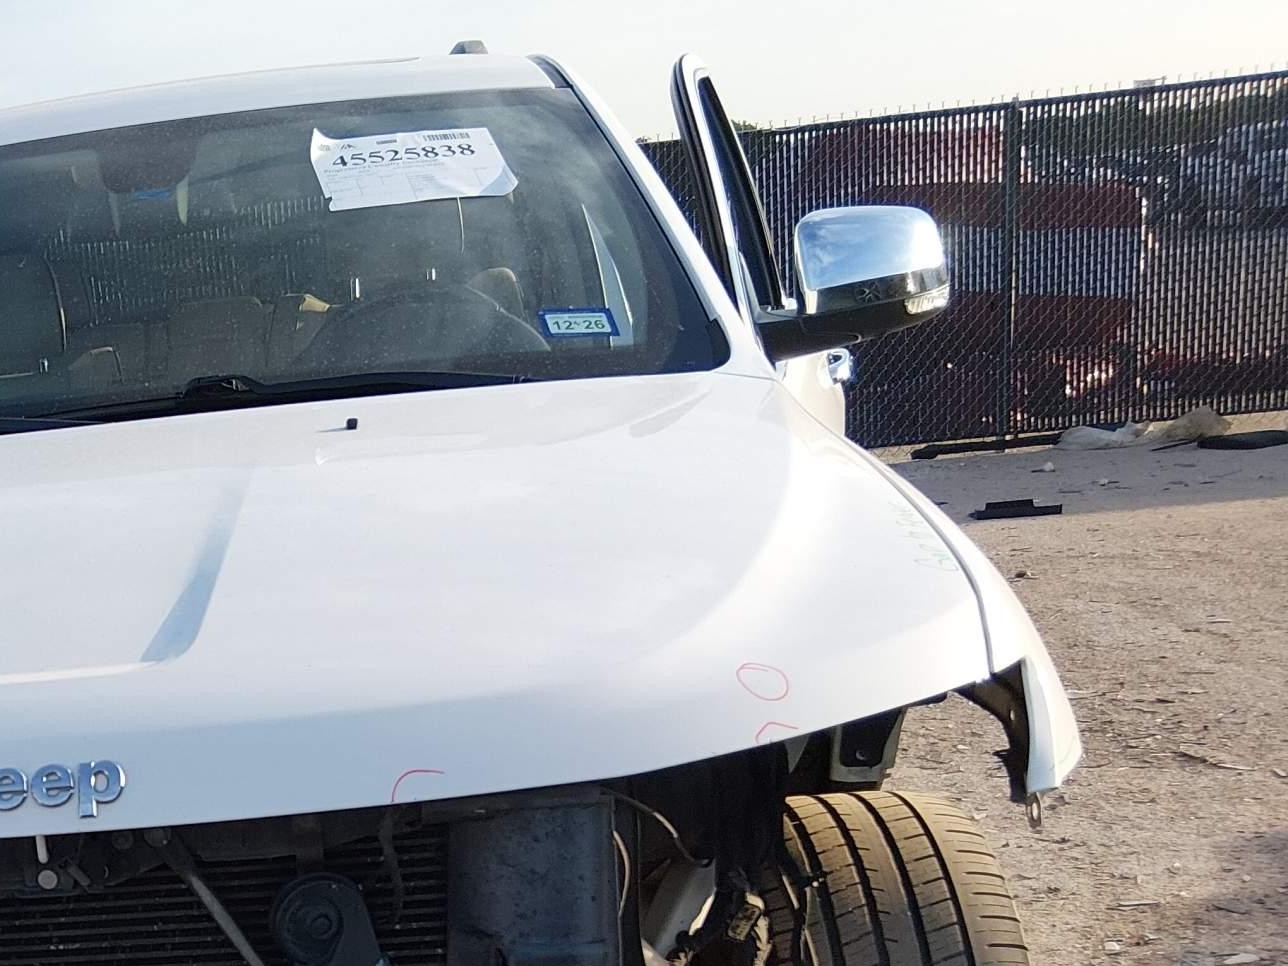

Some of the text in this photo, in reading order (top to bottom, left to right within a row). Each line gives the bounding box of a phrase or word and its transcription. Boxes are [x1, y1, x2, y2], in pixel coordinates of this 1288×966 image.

[332, 143, 475, 167] 45525838
[552, 319, 605, 331] 12 26
